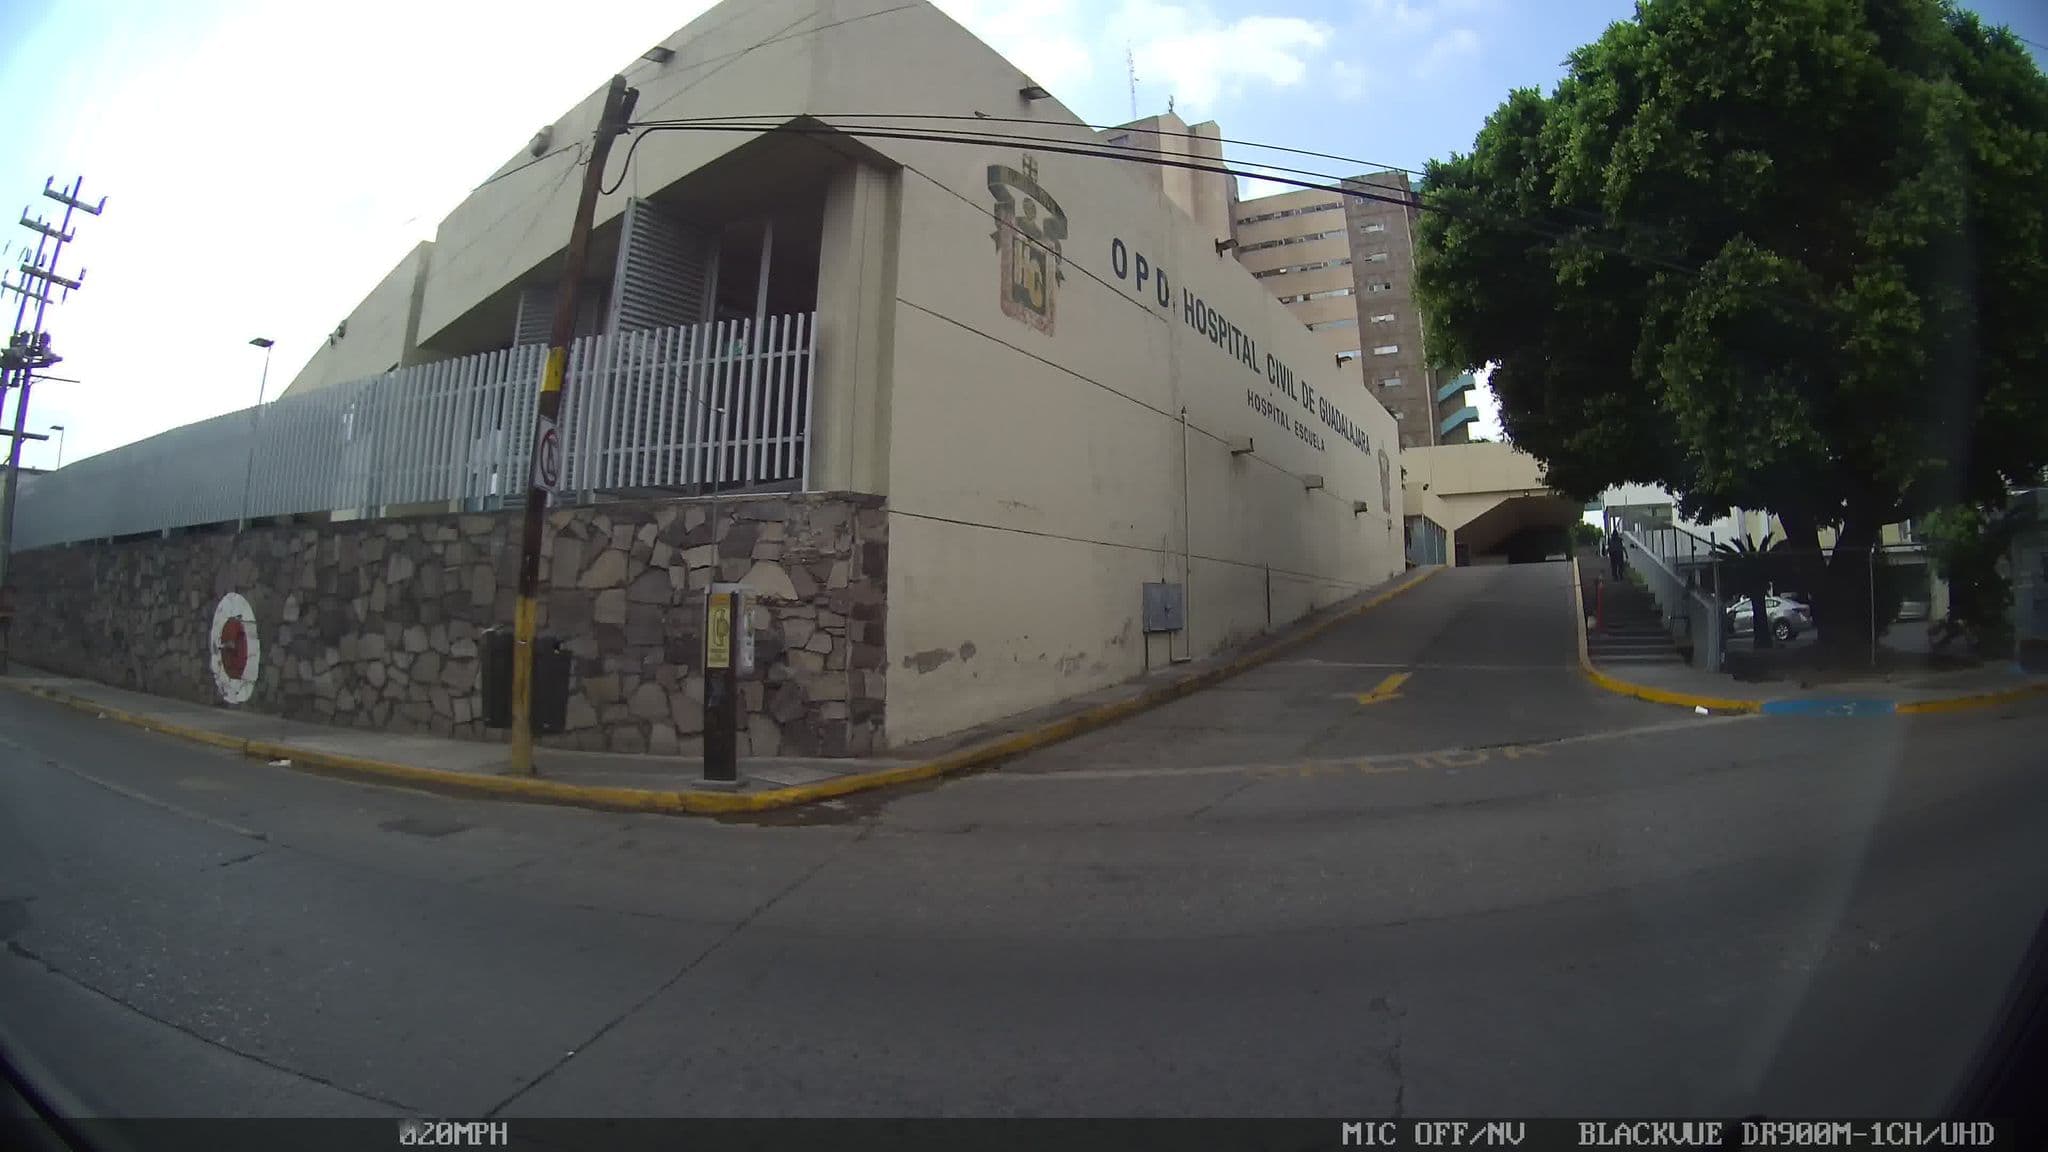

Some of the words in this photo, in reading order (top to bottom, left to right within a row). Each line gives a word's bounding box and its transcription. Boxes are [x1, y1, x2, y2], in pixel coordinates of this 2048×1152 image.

[1183, 287, 1261, 374] HOSPITAL
[1266, 353, 1298, 401] CIVIL
[1301, 379, 1315, 414] DE
[1319, 396, 1371, 456] GUADALAJARA
[1247, 389, 1291, 431] HOSPITAL
[1294, 420, 1326, 451] ESCUELA
